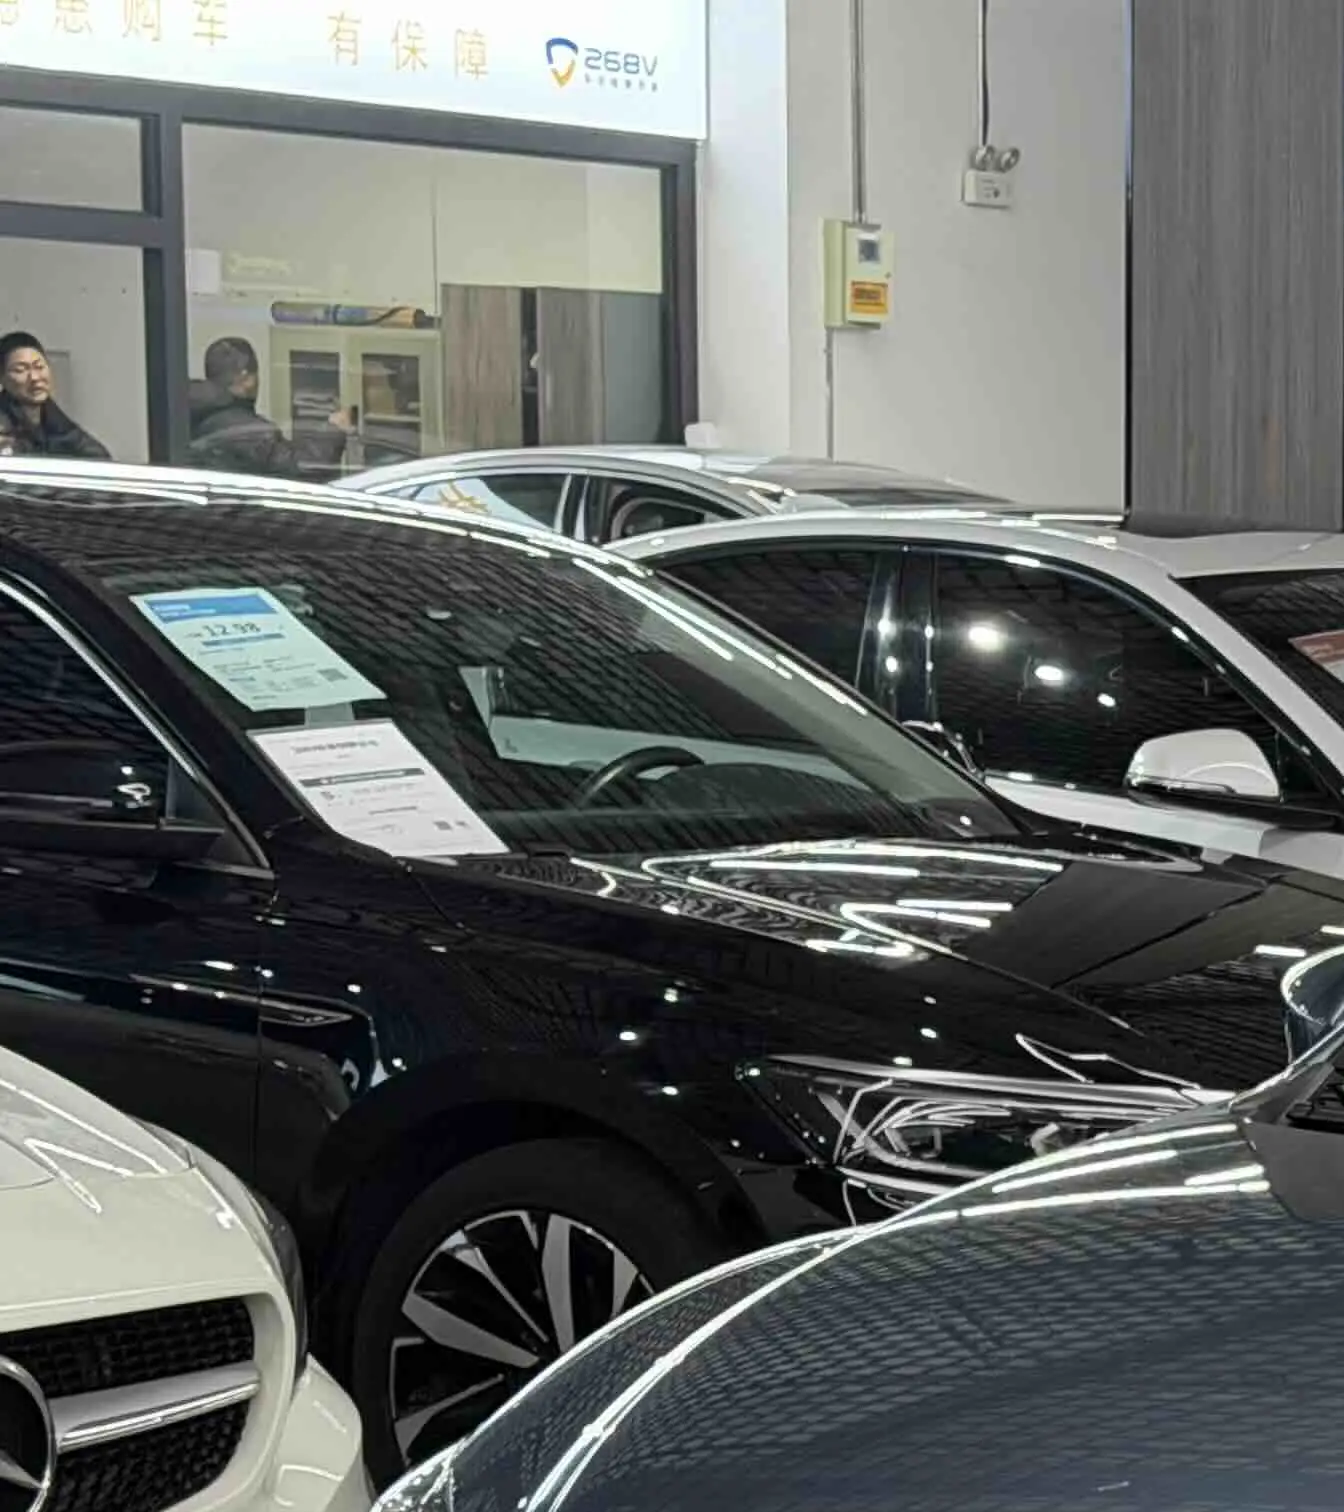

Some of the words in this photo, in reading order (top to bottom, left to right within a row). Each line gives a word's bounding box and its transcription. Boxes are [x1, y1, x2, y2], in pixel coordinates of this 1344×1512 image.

[326, 11, 489, 79] 有保障
[584, 47, 658, 77] 268V
